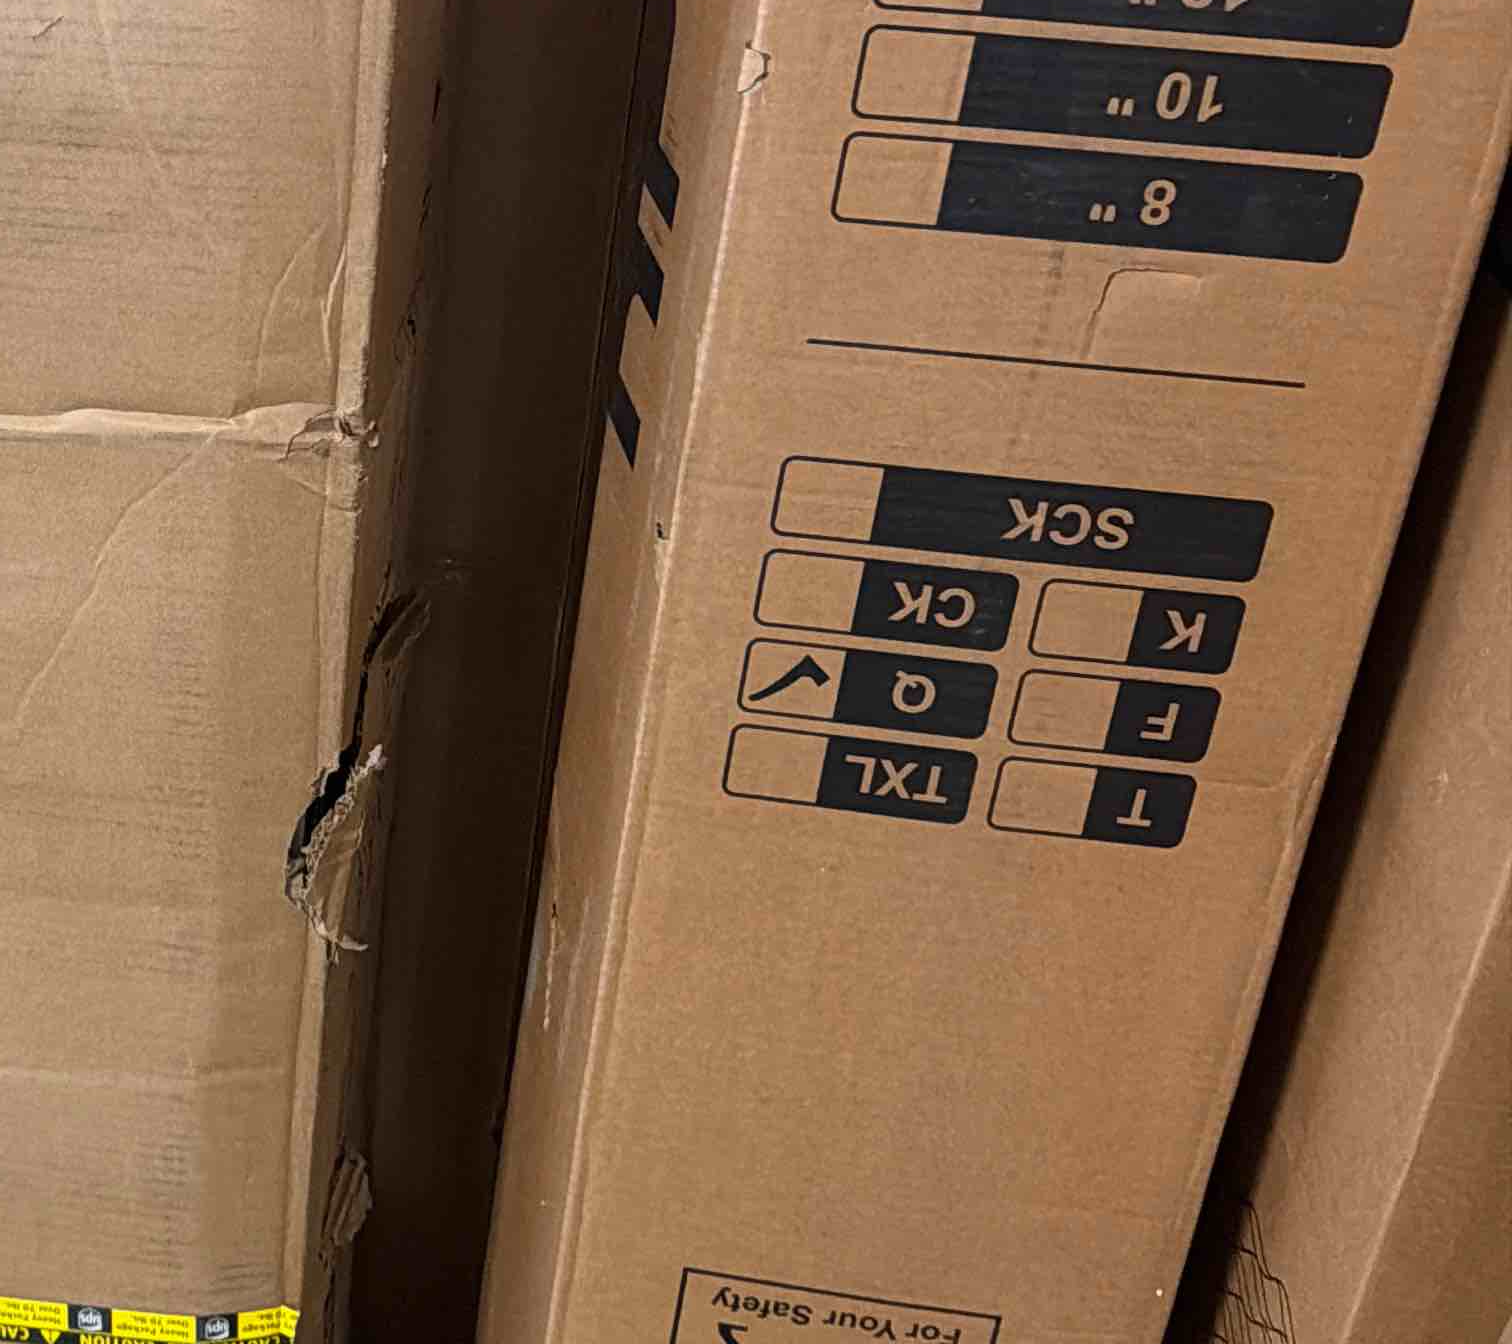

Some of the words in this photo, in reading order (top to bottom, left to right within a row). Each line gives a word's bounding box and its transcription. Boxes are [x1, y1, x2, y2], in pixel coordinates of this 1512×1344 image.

[1002, 495, 1135, 549] SCK
[892, 580, 975, 629] CK
[1161, 608, 1207, 652] K
[892, 670, 937, 713] Q
[1145, 700, 1180, 740] F
[845, 751, 948, 805] TXL
[1116, 786, 1151, 827] T
[711, 1287, 813, 1326] Safety
[821, 1308, 897, 1343] Your
